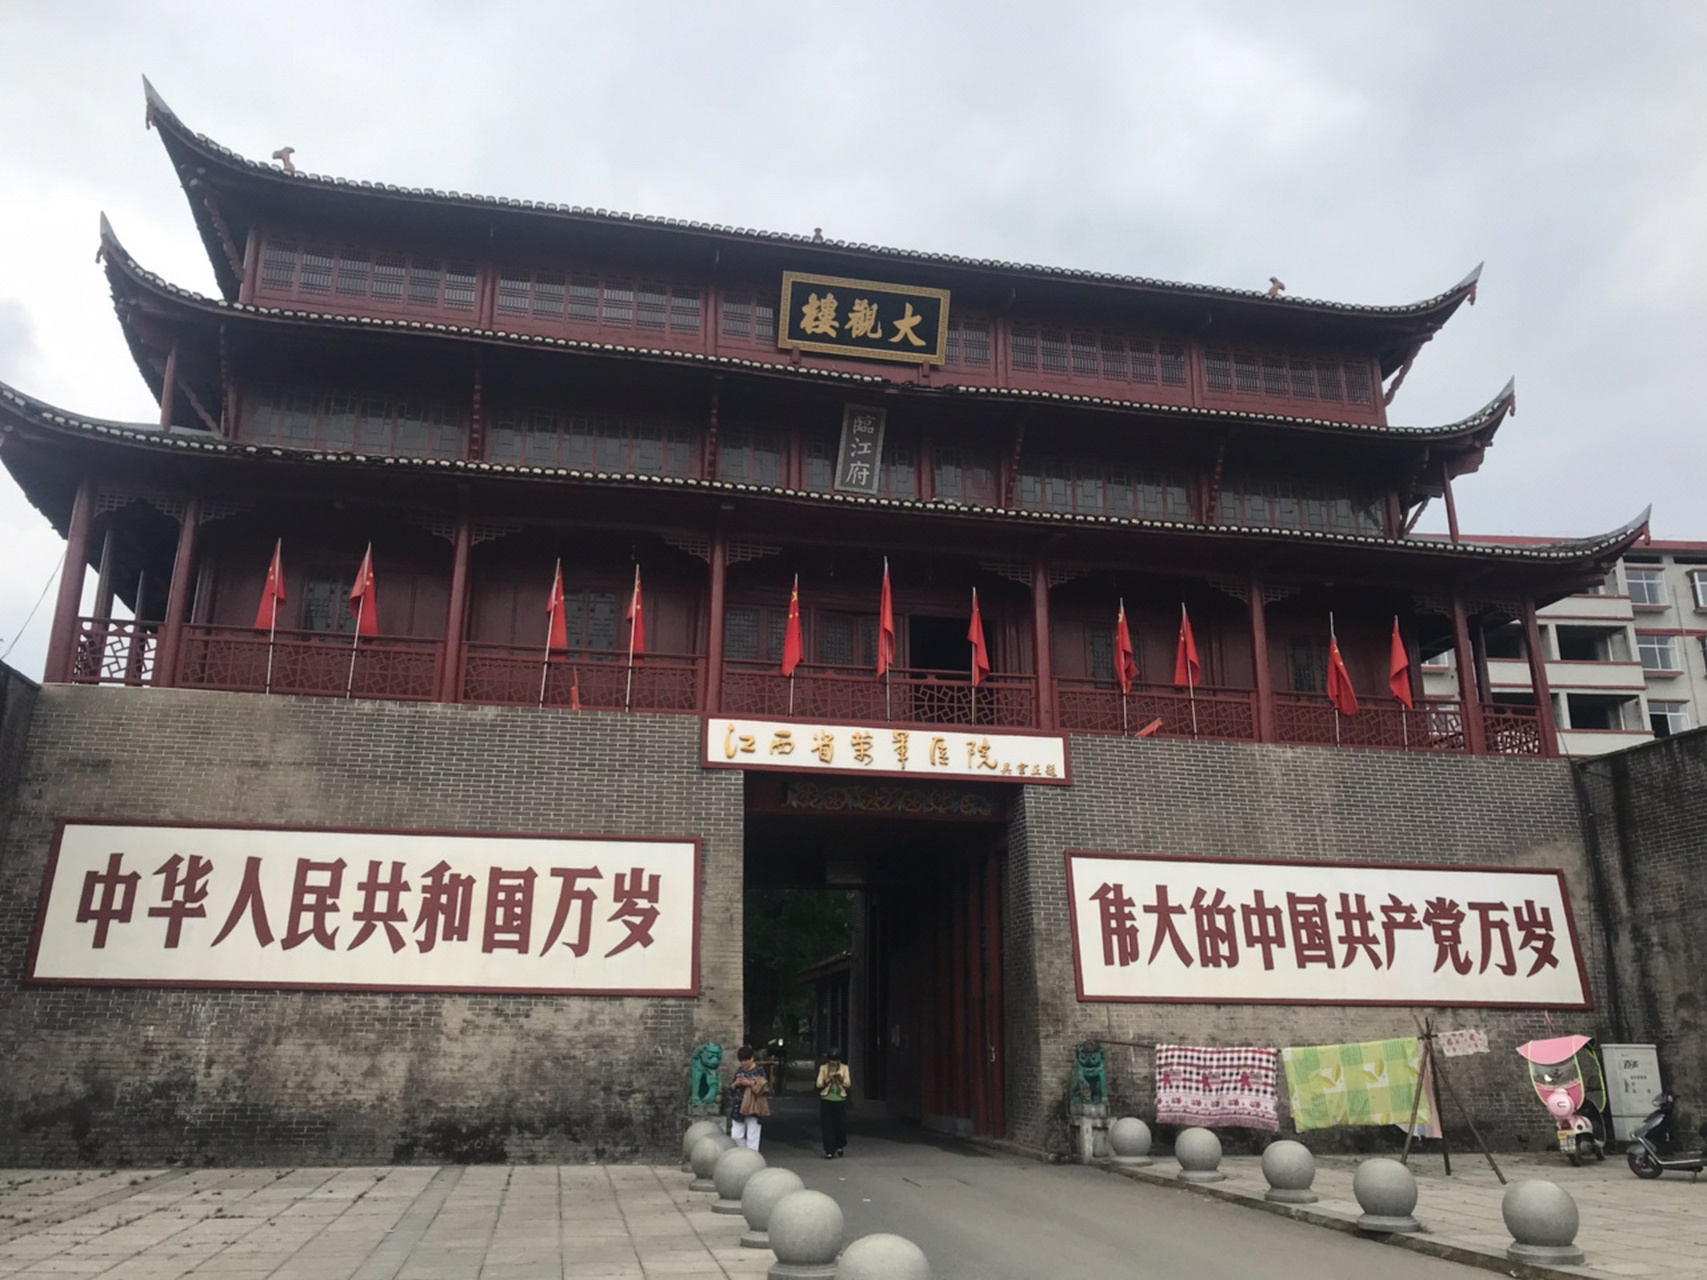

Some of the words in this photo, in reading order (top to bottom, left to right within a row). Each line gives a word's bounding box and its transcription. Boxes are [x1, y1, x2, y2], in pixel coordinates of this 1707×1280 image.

[75, 852, 662, 958] 中华人民共和国万岁
[1089, 881, 1560, 978] 伟大的中国共产党万岁
